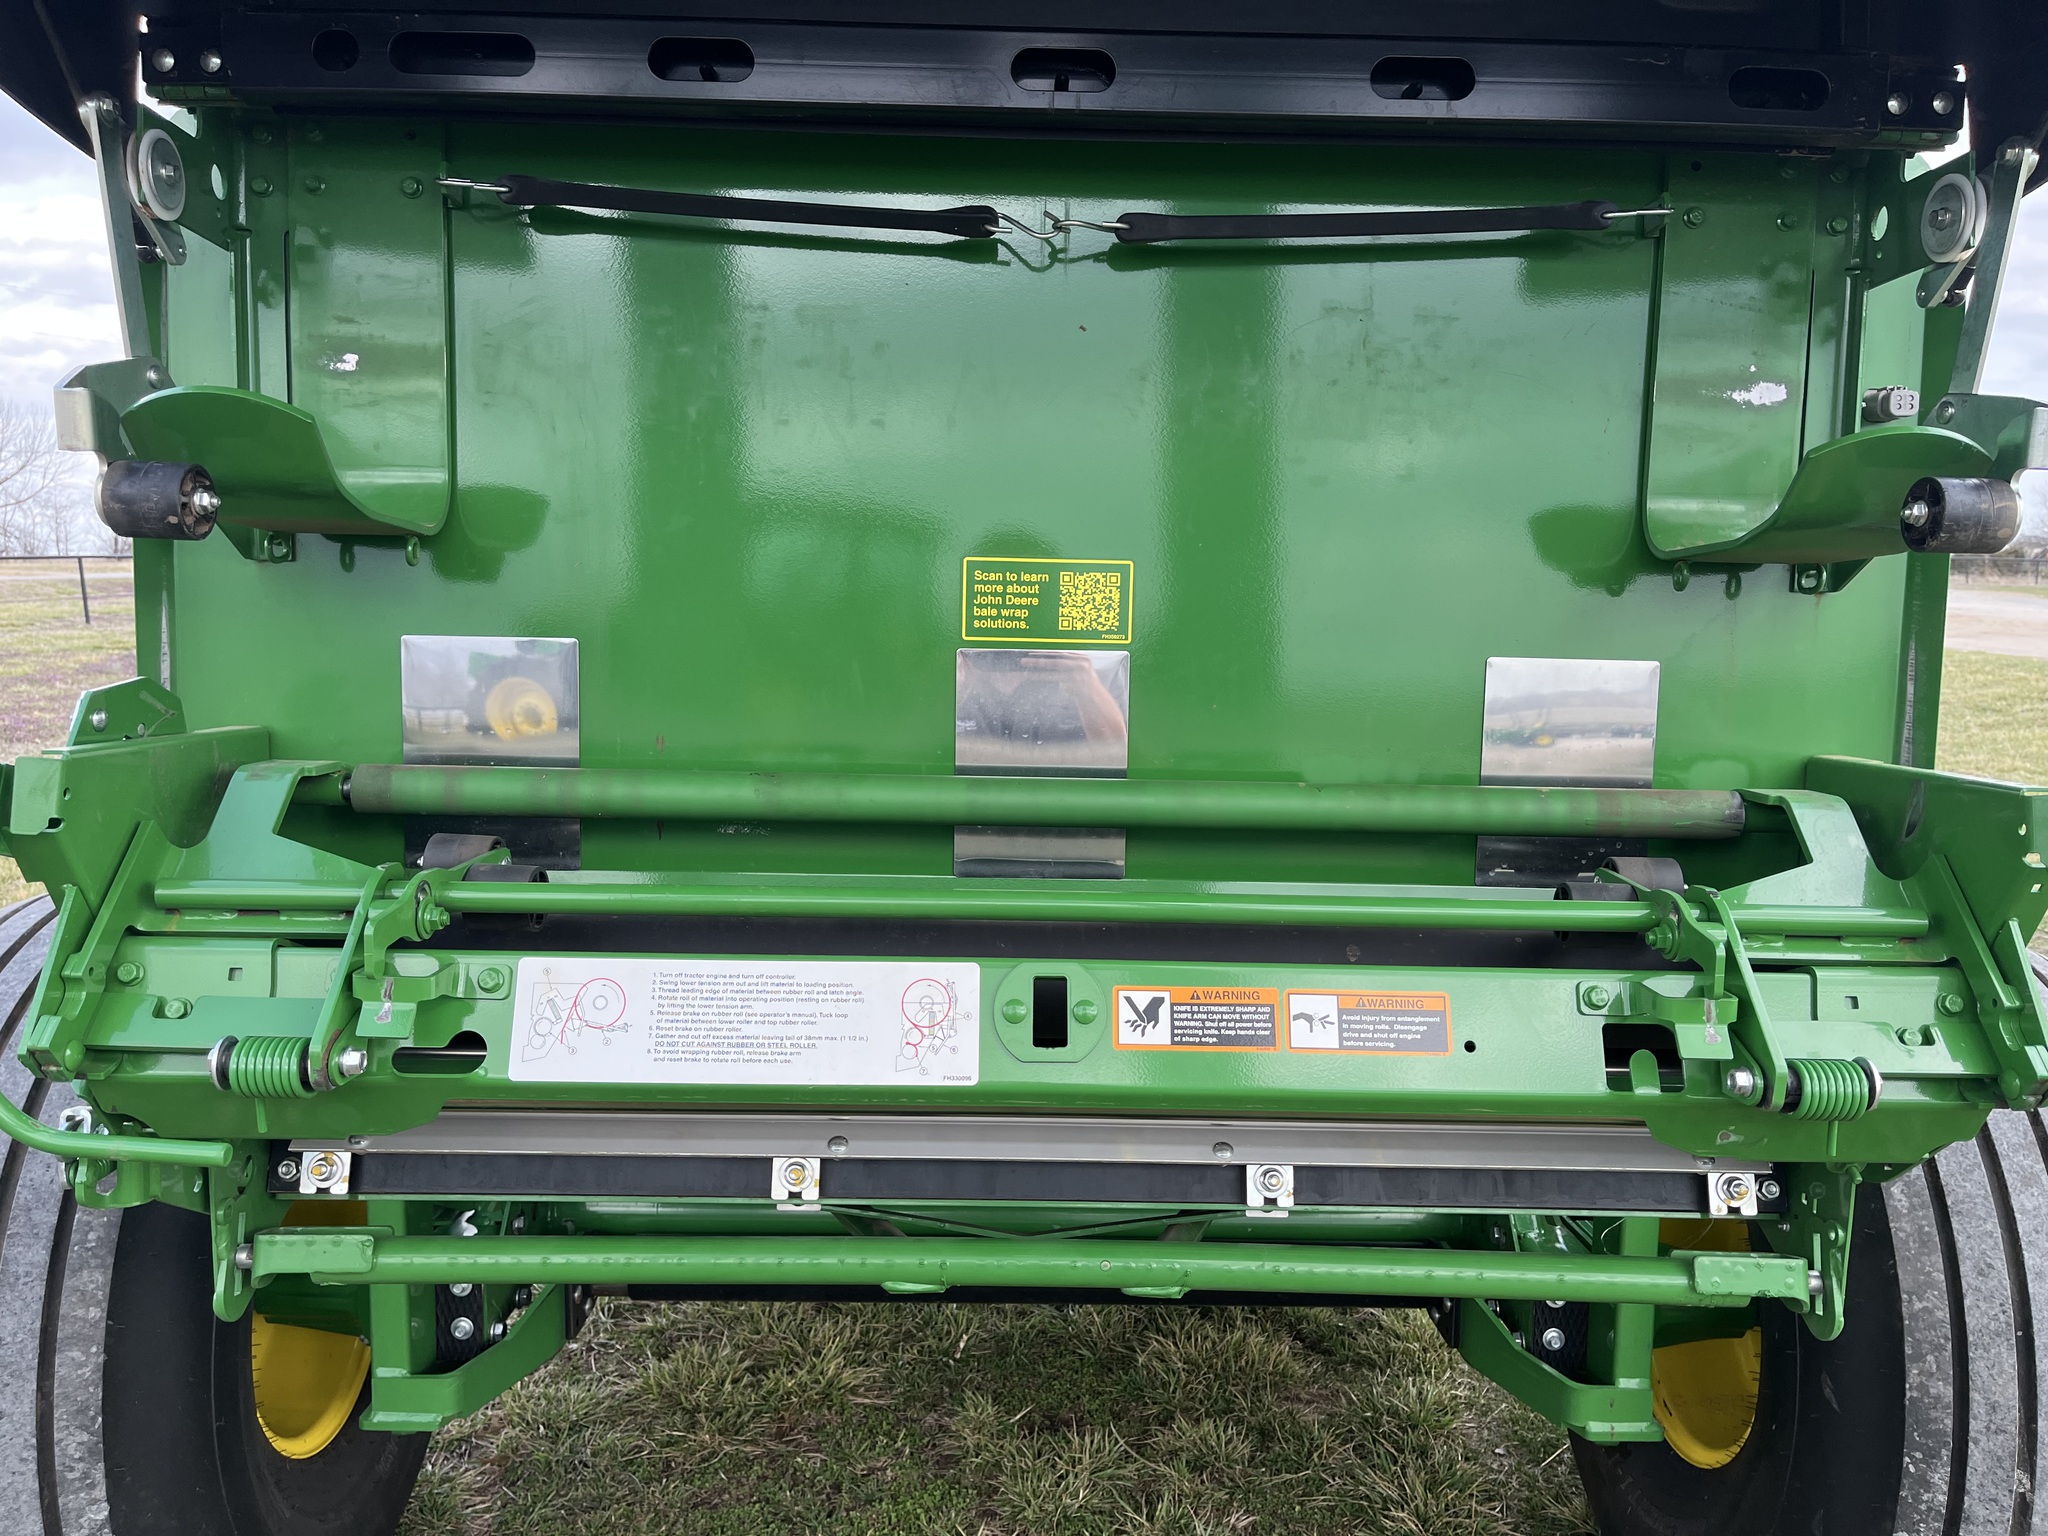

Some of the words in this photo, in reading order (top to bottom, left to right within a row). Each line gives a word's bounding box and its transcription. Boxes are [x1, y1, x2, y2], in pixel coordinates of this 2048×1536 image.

[974, 570, 1003, 581] Scan
[1006, 571, 1017, 581] to
[1021, 571, 1049, 582] learn
[974, 585, 1003, 593] more
[1006, 584, 1039, 594] about
[974, 594, 1002, 605] John
[1006, 595, 1039, 605] Deere
[974, 606, 998, 617] bale
[1000, 609, 1028, 619] wrap
[974, 618, 1029, 629] solutions.
[1202, 990, 1260, 1000] WARNING
[1366, 999, 1424, 1009] WARNING
